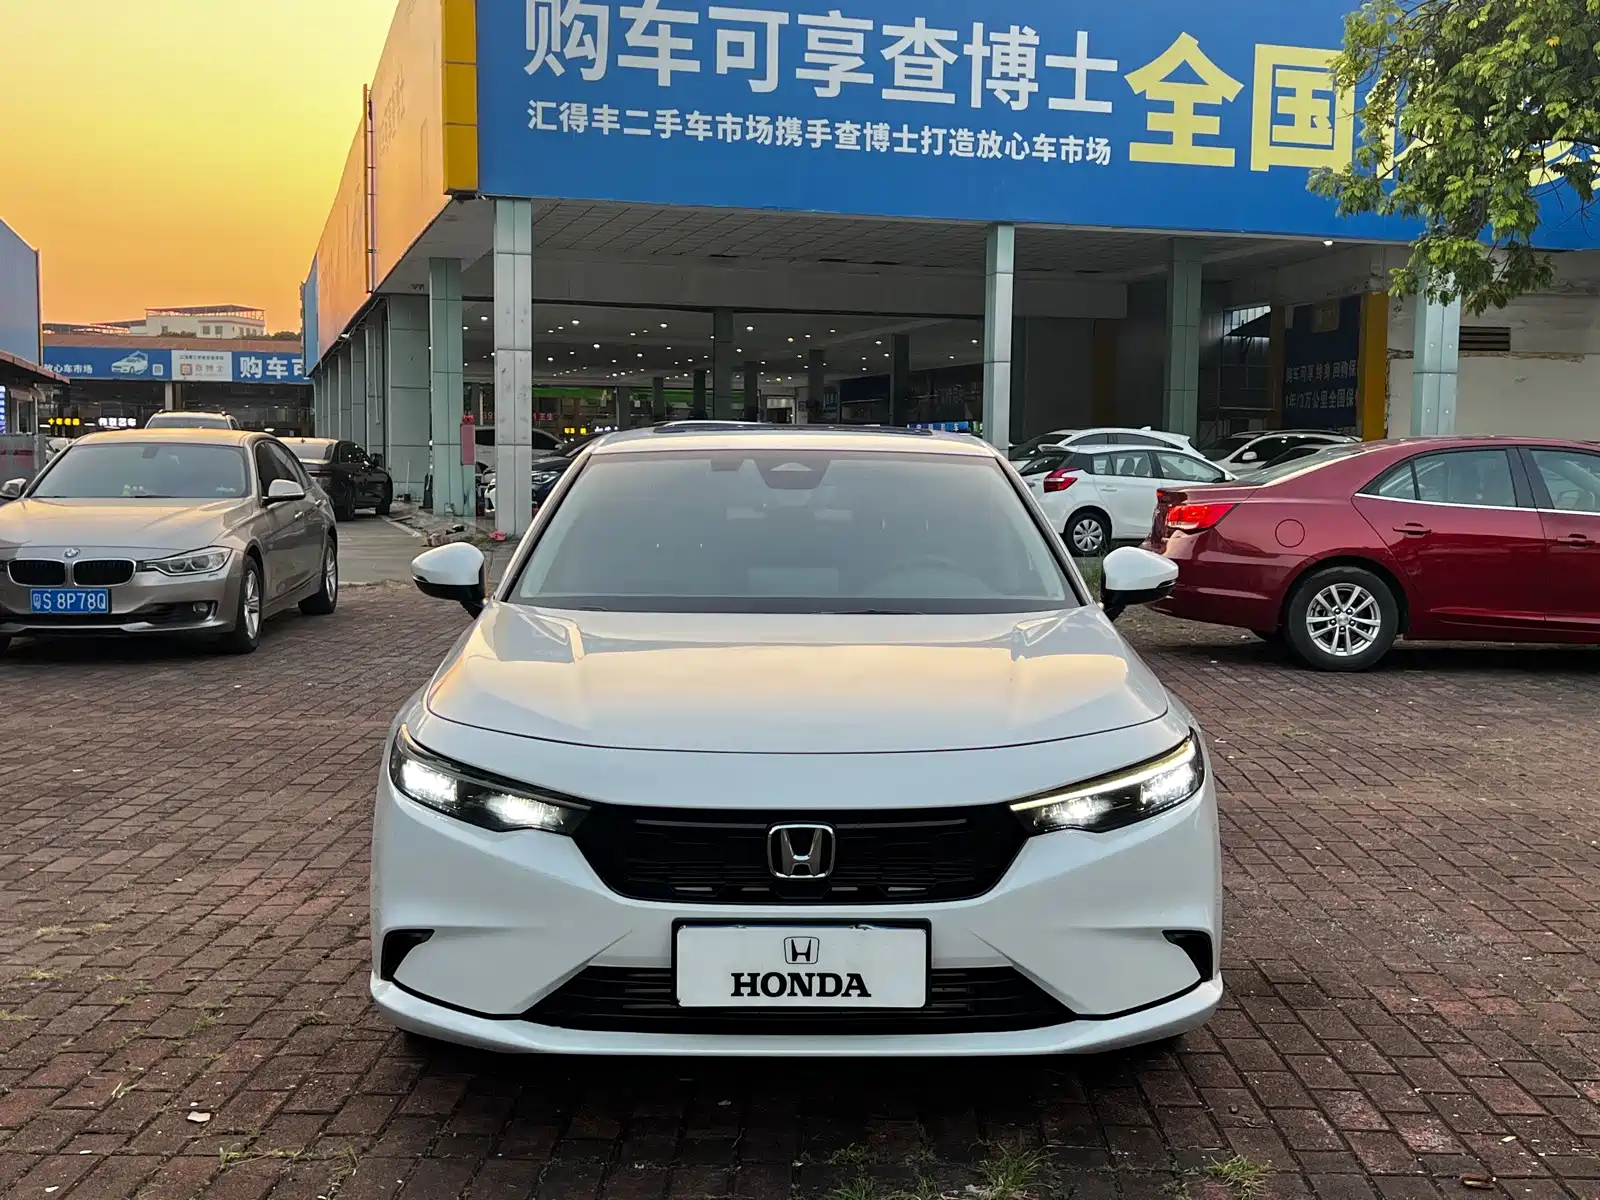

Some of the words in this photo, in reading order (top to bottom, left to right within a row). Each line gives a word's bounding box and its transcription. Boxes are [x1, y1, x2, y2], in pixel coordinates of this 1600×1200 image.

[527, 99, 1112, 166] 汇得丰二手车市场携手查博士打造放心车市场
[731, 972, 871, 997] HONDA
